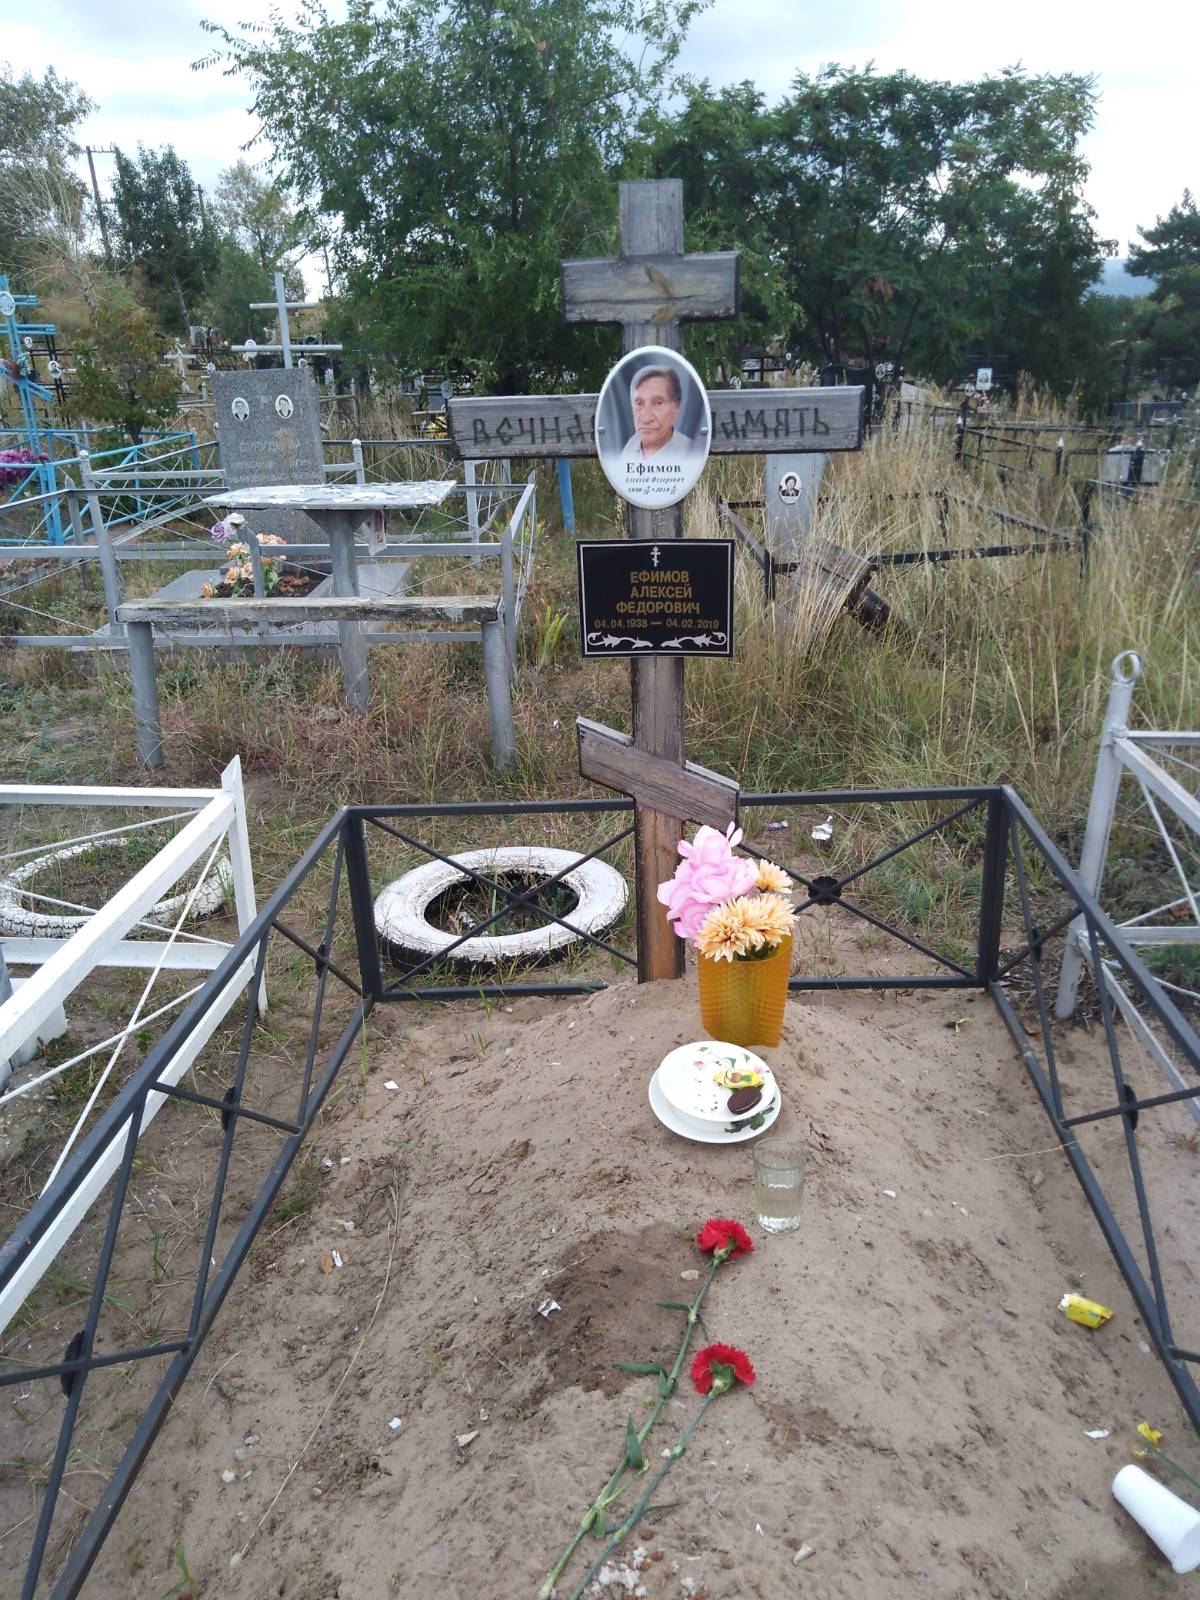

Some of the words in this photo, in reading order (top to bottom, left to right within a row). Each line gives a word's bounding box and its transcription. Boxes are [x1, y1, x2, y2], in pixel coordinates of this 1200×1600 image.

[473, 414, 597, 446] ВЕЧНА
[625, 462, 682, 476] Ефимов
[630, 570, 690, 584] ЕФИМОВ
[630, 583, 693, 599] АЛЕКСЕЙ
[616, 601, 700, 616] ФЕДОРОВИЧ
[594, 618, 648, 629] 04.04.1938
[666, 618, 720, 630] 04.02.2019
